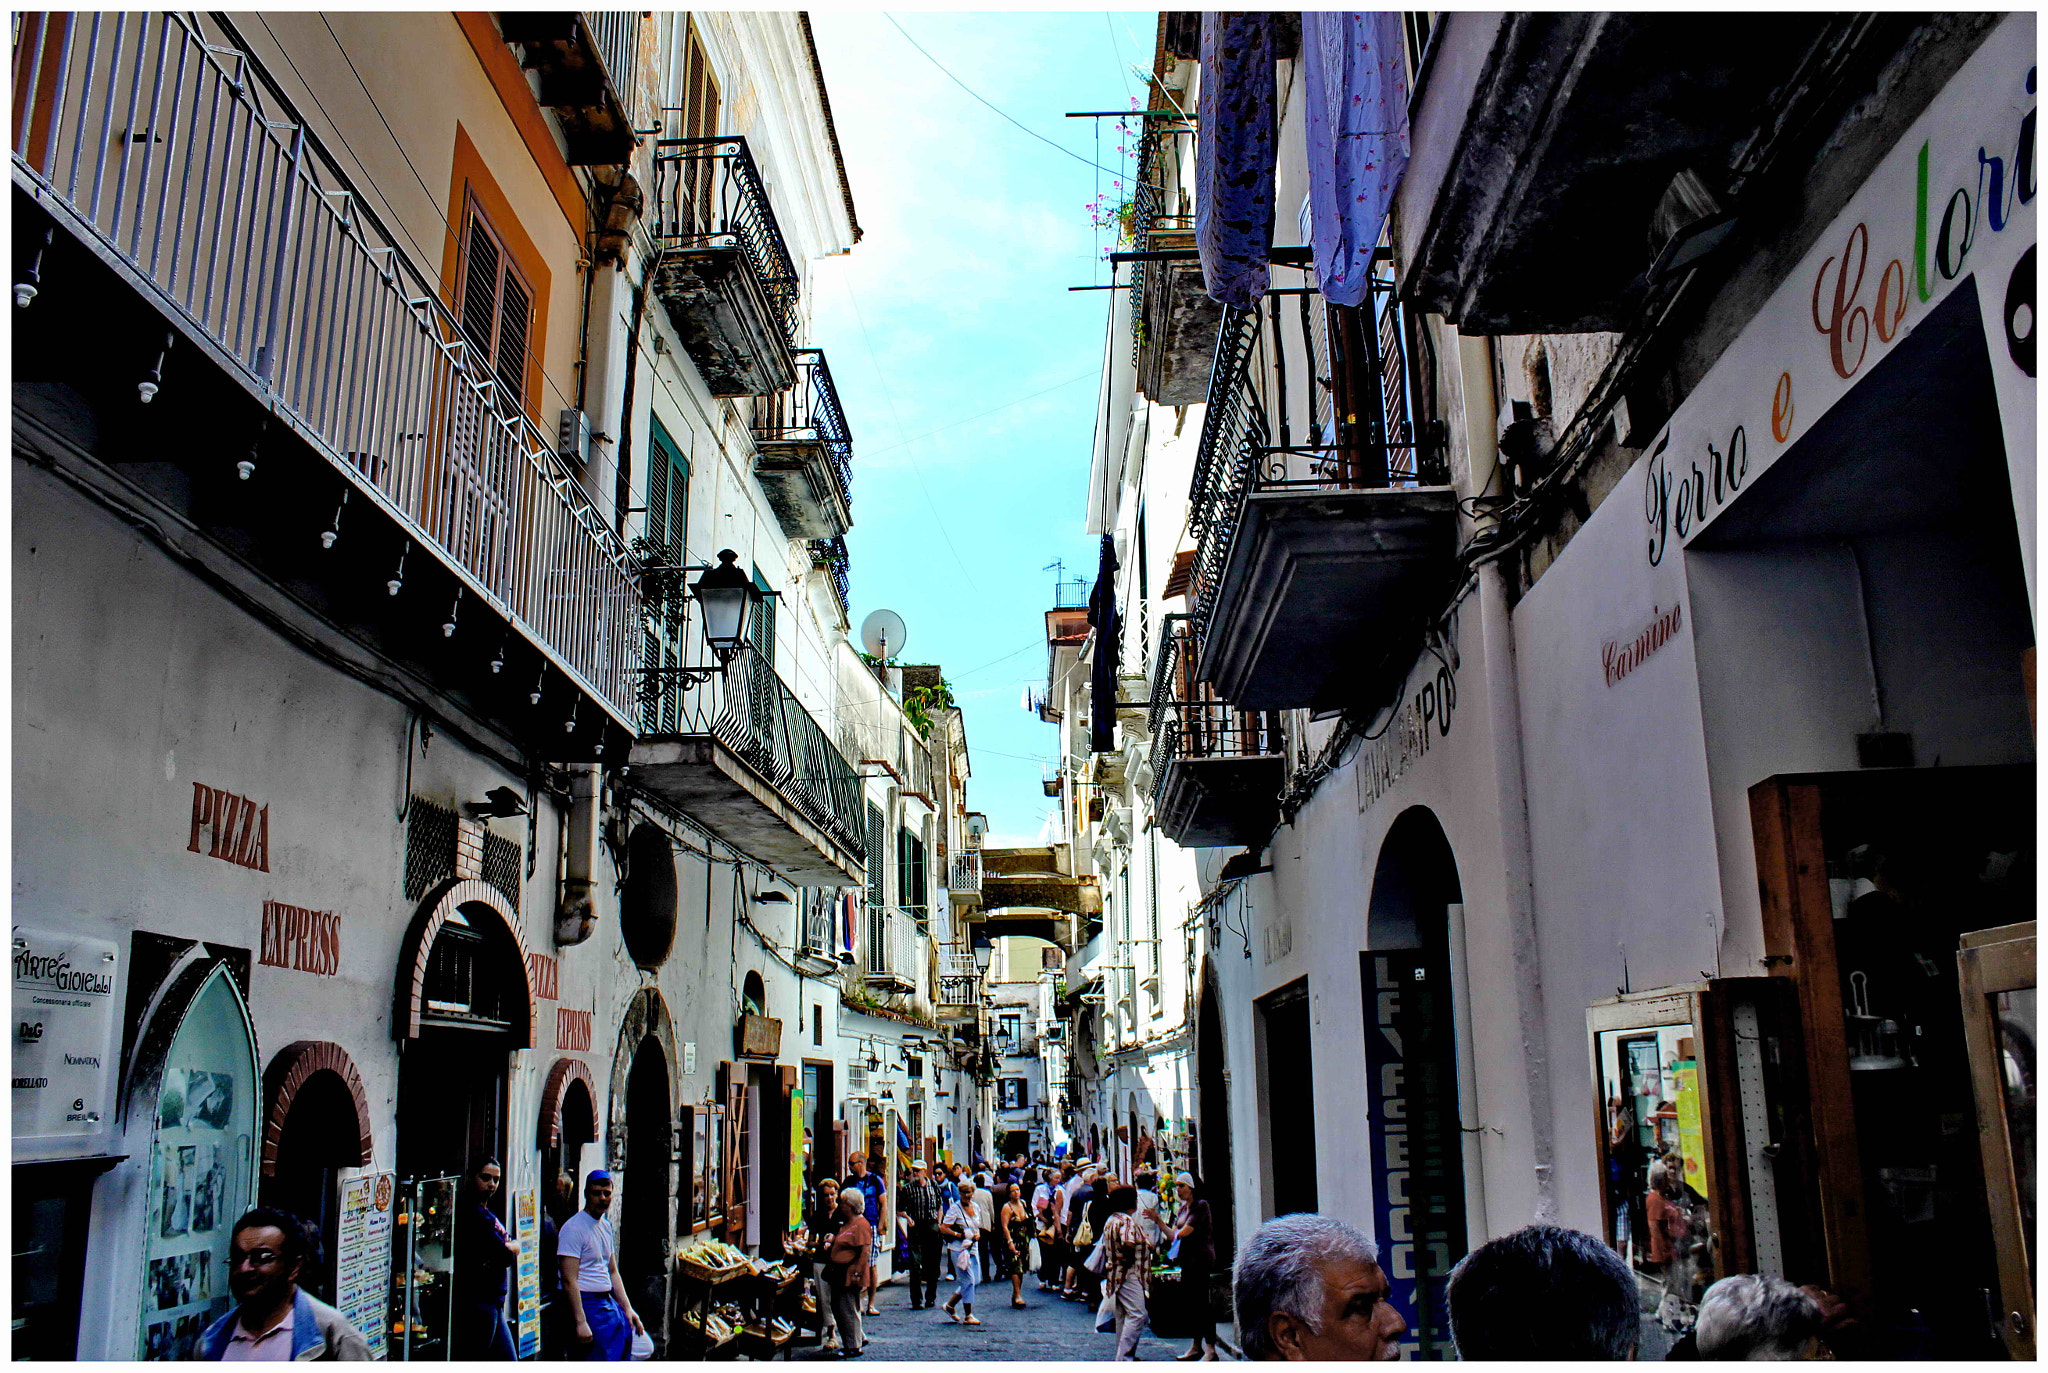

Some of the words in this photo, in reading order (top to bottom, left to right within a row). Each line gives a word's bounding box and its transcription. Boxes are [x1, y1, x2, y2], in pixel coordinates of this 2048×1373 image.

[1645, 422, 1749, 568] Ferro
[1771, 371, 1794, 444] e
[1812, 65, 2037, 380] Colori
[1602, 603, 1682, 687] Carmine
[187, 780, 270, 873] PIZZA
[258, 899, 341, 978] EXPRESS
[556, 1007, 592, 1052] EXPRESS
[66, 1113, 88, 1122] BREIL
